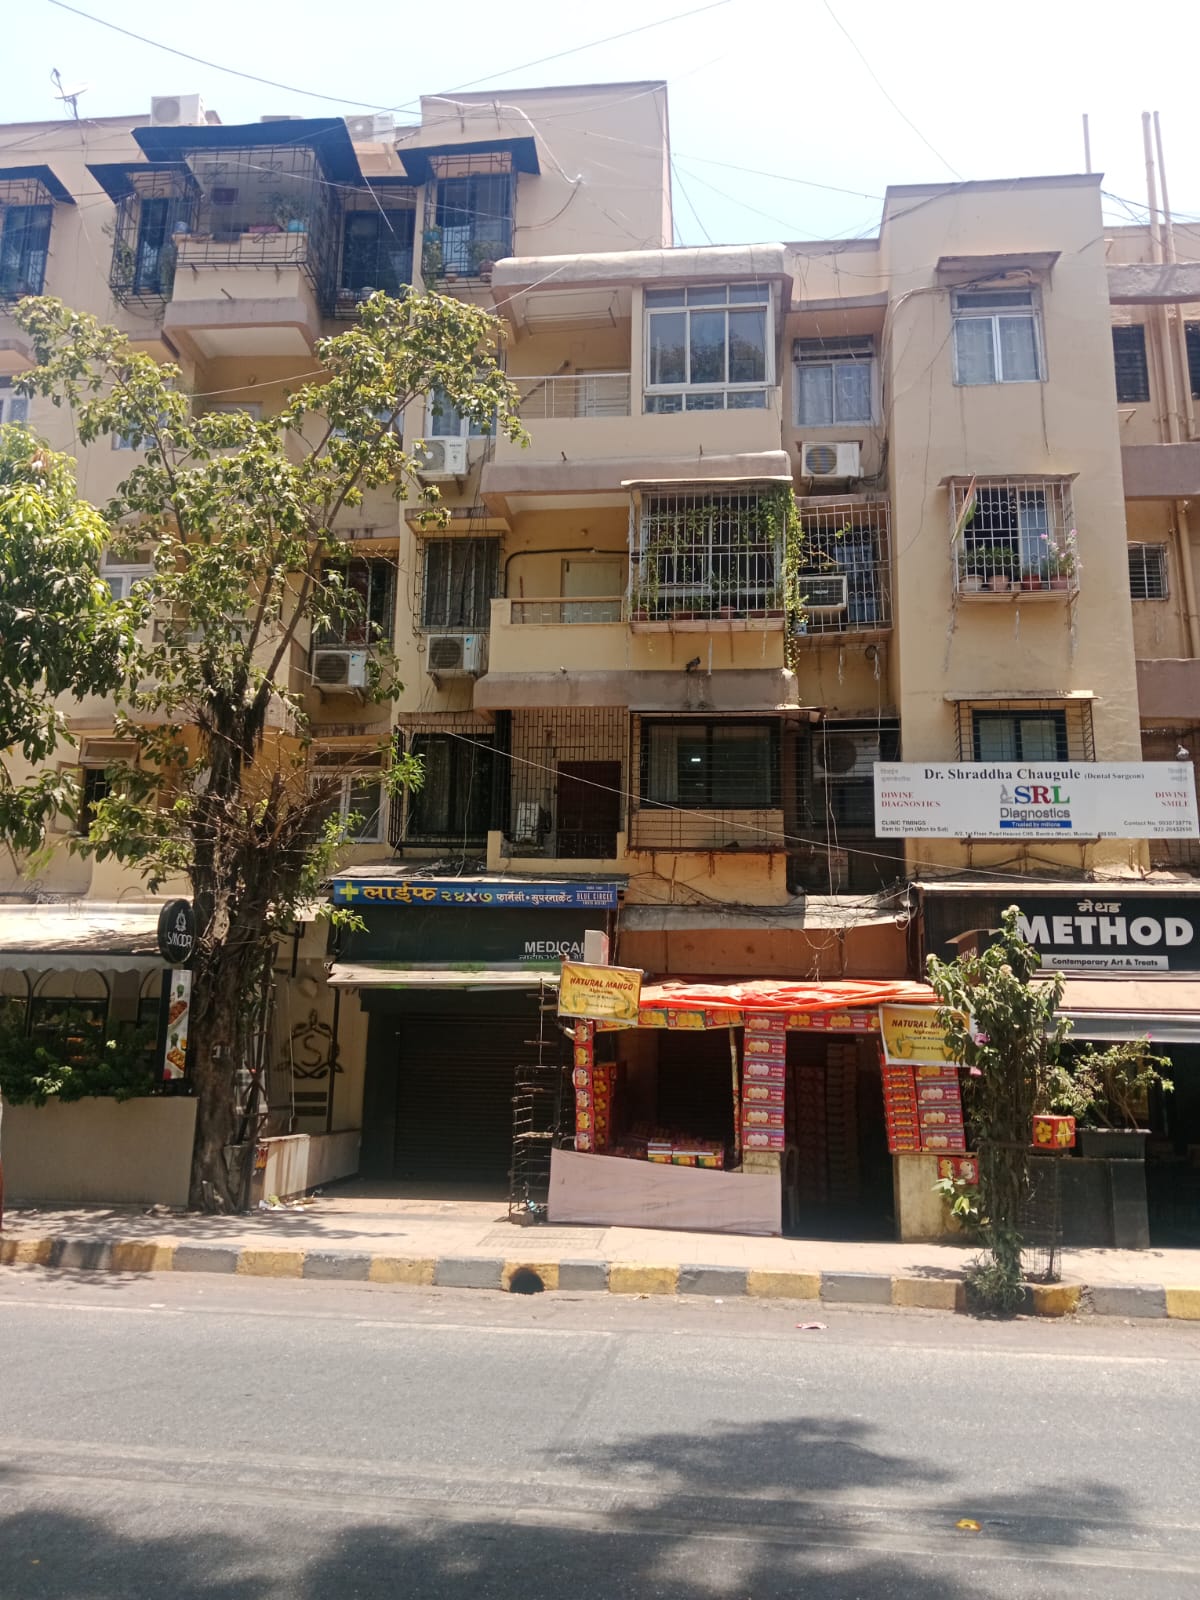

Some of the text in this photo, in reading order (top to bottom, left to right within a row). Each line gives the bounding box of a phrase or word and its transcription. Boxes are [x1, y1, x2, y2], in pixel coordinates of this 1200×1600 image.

[924, 768, 944, 780] Dr.
[948, 768, 1013, 780] Shraddha
[1016, 768, 1081, 782] Chaugule
[881, 791, 914, 799] DIWINE
[1014, 785, 1071, 805] SRL
[1155, 791, 1189, 799] DIWINE
[881, 800, 942, 808] DIAGNOSTICS
[1161, 800, 1190, 808] SMILE
[1000, 807, 1071, 822] Diagnostics
[362, 881, 438, 903] लाईफ
[576, 892, 591, 900] BLUE
[1077, 899, 1122, 913] मेथड
[1017, 915, 1194, 946] METHOD
[1051, 957, 1108, 967] Contemporary
[1111, 958, 1123, 966] Art
[1134, 959, 1158, 967] Treats
[570, 977, 634, 991] NATURAL MANGO
[891, 1019, 929, 1029] NATURAL
